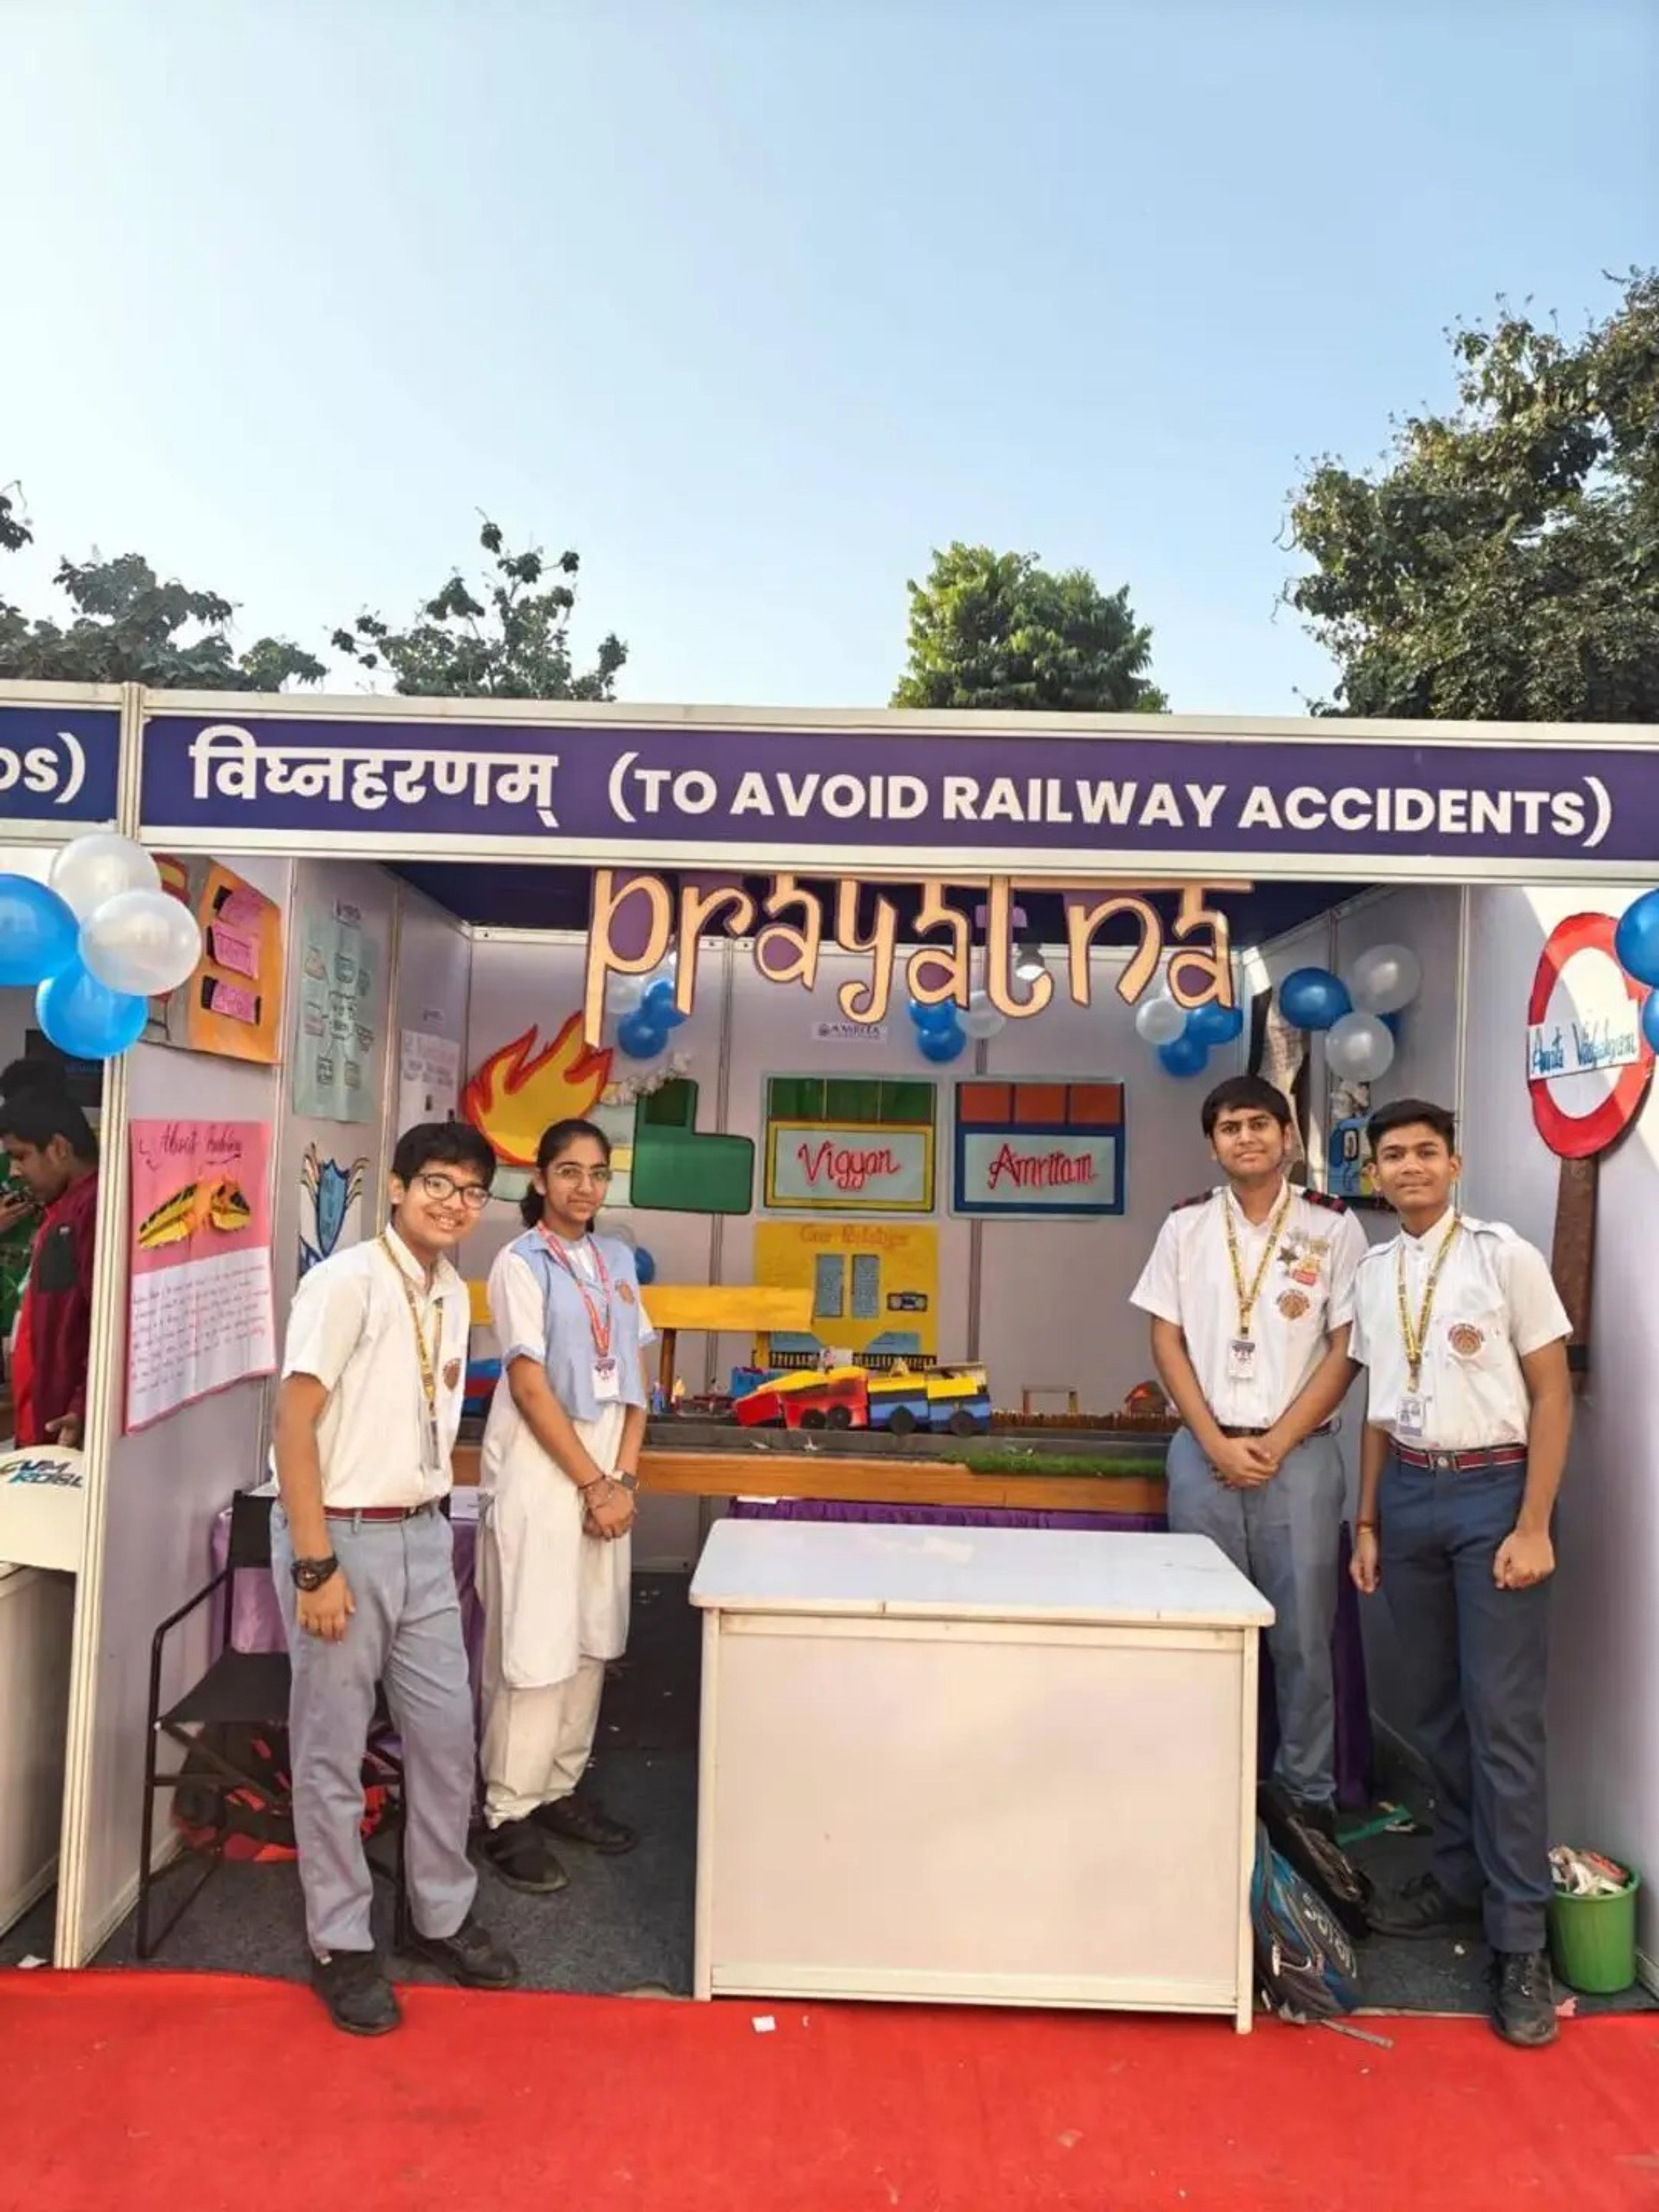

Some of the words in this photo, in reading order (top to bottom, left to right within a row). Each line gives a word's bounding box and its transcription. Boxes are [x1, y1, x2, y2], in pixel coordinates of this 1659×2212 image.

[189, 725, 559, 827] विघ्नहरणम्
[609, 752, 717, 822] (TO
[730, 772, 928, 819] AVOID
[943, 776, 1226, 827] RAILWAY
[1238, 776, 1612, 847] ACCIDENTS)
[798, 1141, 901, 1191] Vigyan
